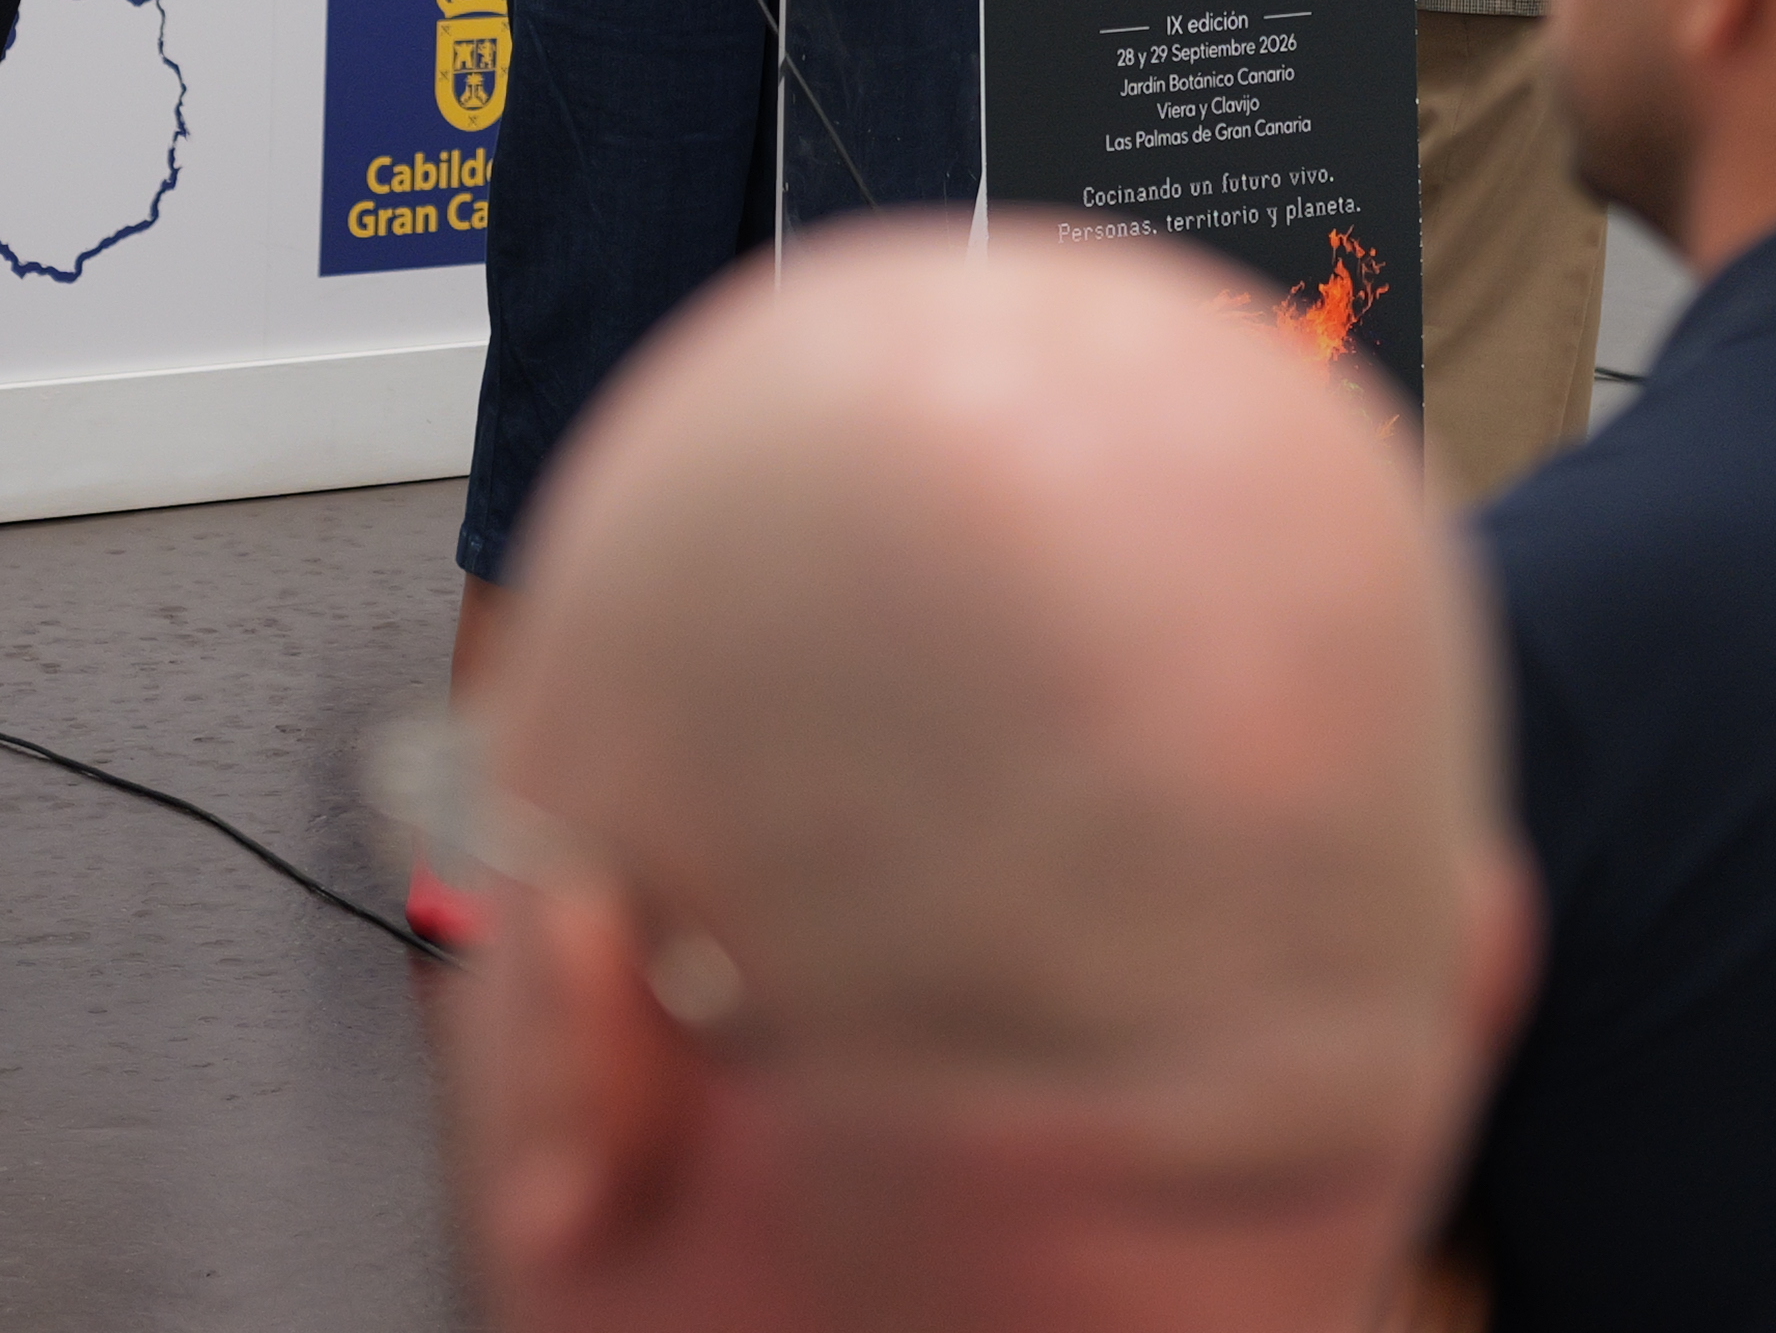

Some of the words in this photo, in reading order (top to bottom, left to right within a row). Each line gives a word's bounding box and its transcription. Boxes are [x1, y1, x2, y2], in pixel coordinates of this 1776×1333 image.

[1166, 15, 1184, 36] IX
[1187, 11, 1249, 34] edición
[1116, 49, 1135, 68] 28
[1138, 51, 1148, 70] y
[1150, 45, 1168, 65] 29
[1172, 37, 1256, 65] Septiembre
[1259, 33, 1298, 54] 2026
[1120, 76, 1166, 97] Jardín
[1169, 71, 1235, 93] Botánico
[1237, 64, 1295, 86] Canario
[1156, 100, 1196, 120] Viera
[1199, 103, 1209, 121] y
[1211, 94, 1260, 117] Clavijo
[1105, 133, 1132, 152] Las
[1135, 128, 1189, 149] Palmas
[1192, 125, 1212, 143] de
[1215, 121, 1252, 142] Gran
[1254, 116, 1312, 138] Canaria
[366, 147, 494, 194] Cabild
[1082, 176, 1182, 208] Cocinando
[1190, 179, 1213, 196] un
[1221, 172, 1281, 194] futuro
[1288, 166, 1335, 186] vivo.
[348, 200, 439, 238] Gran
[1166, 208, 1259, 233] territorio
[1266, 206, 1279, 228] y
[1285, 196, 1362, 226] planeta.
